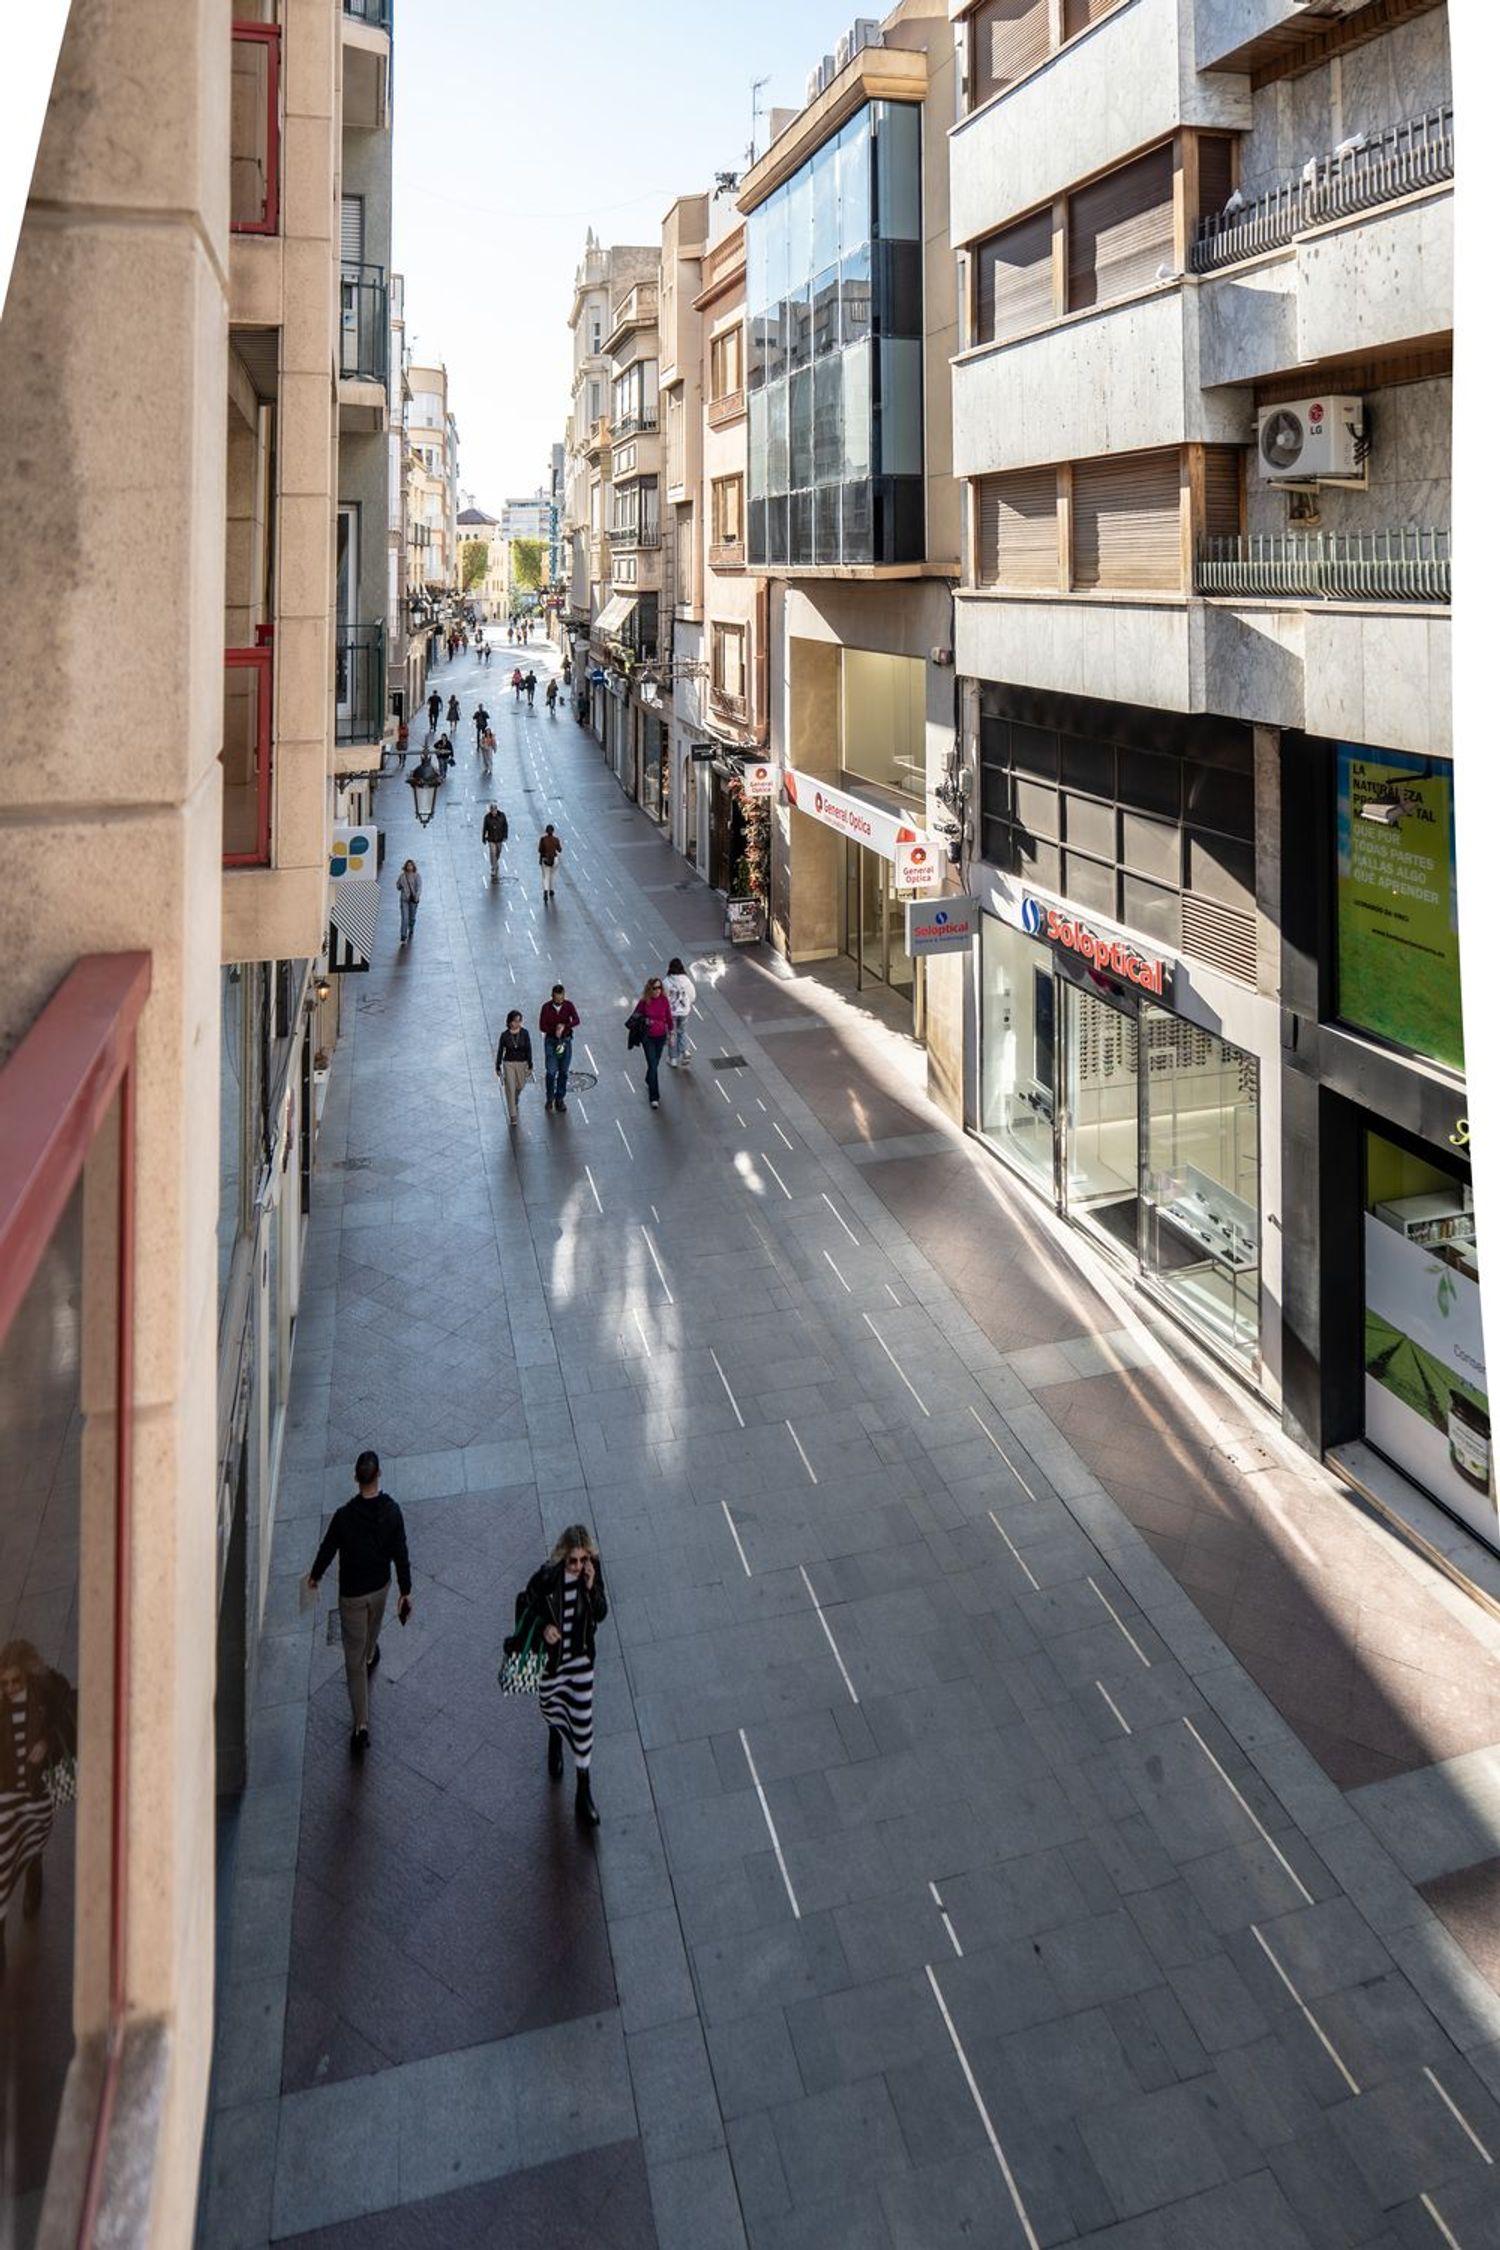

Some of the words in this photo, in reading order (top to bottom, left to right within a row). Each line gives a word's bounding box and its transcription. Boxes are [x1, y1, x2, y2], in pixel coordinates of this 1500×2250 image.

[1309, 425, 1323, 435] LG
[1353, 764, 1366, 776] LA
[1353, 779, 1424, 803] NATURALEZA
[824, 799, 848, 823] General
[849, 811, 872, 835] Optica
[1416, 808, 1437, 823] TAL
[1354, 825, 1376, 838] QUE
[1378, 830, 1401, 845] POR
[1354, 838, 1388, 857] TODAS
[1390, 849, 1435, 870] PARTES
[903, 866, 934, 875] General
[905, 875, 932, 884] Optica
[1354, 855, 1394, 875] HALLAS
[1396, 867, 1427, 884] ALGO
[1354, 868, 1376, 883] QUE
[1378, 876, 1439, 903] APRENDER
[913, 921, 969, 936] Soloptical
[1047, 910, 1163, 996] Soloptical
